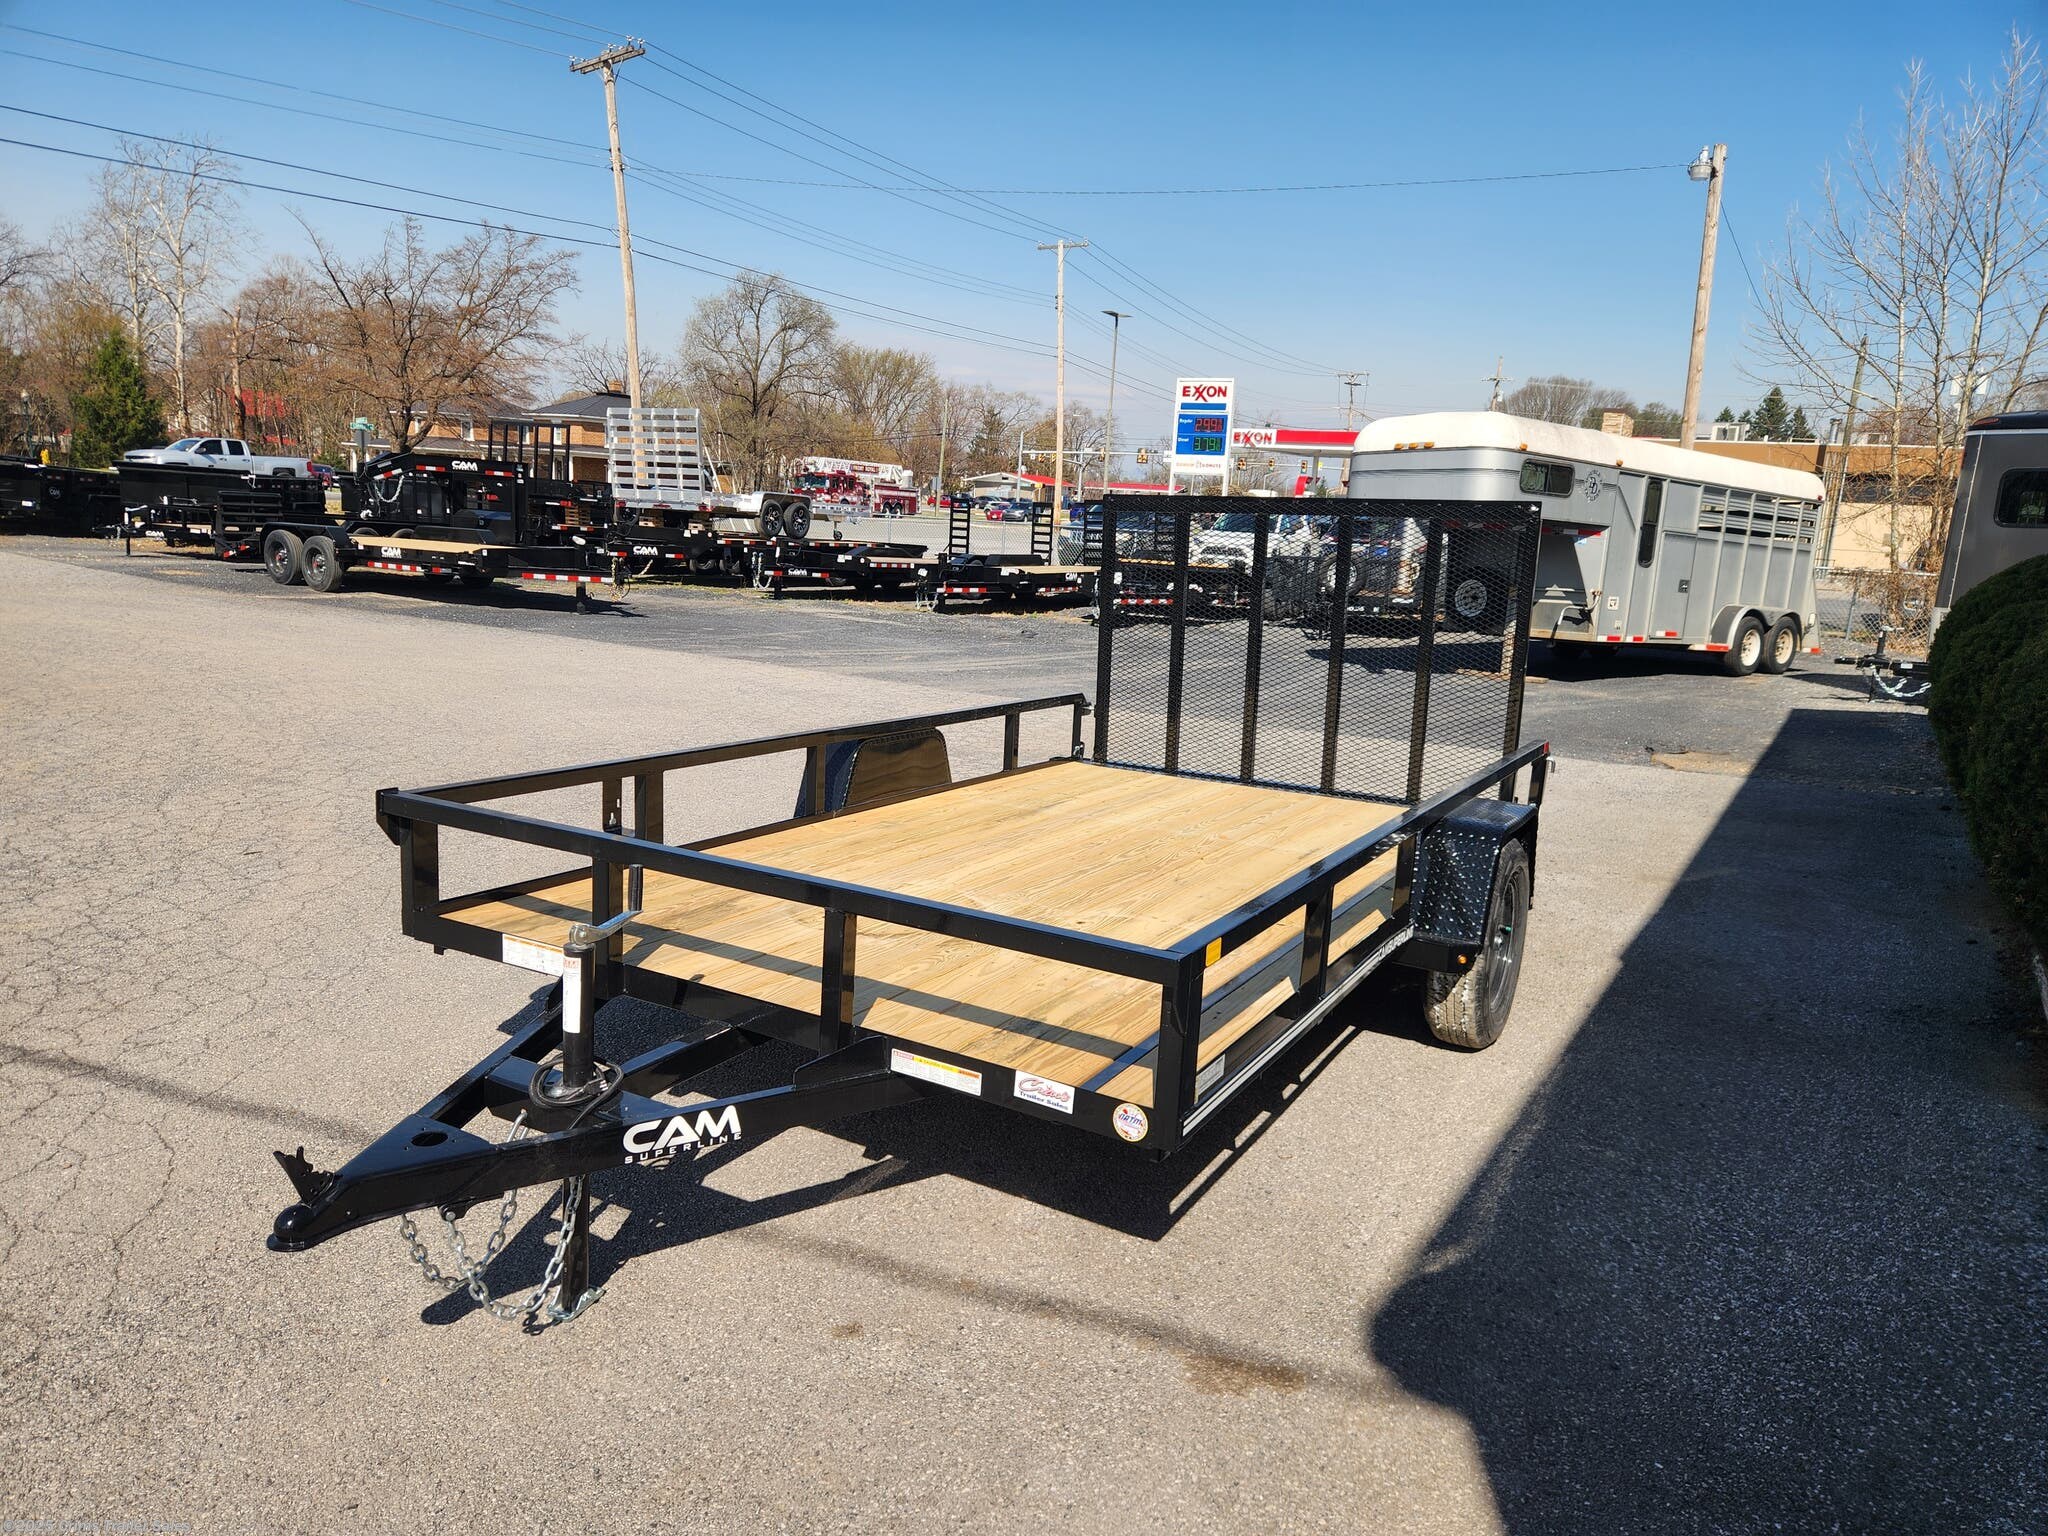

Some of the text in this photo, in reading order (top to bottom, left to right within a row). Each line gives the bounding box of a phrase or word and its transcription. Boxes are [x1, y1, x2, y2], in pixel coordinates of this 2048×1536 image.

[1182, 384, 1228, 402] EXXON
[1233, 430, 1273, 448] EXXON
[451, 460, 478, 471] CAM
[381, 546, 402, 556] CAM
[633, 546, 659, 556] CAM
[623, 1105, 742, 1154] CAM
[624, 1132, 742, 1164] SUPERLINE
